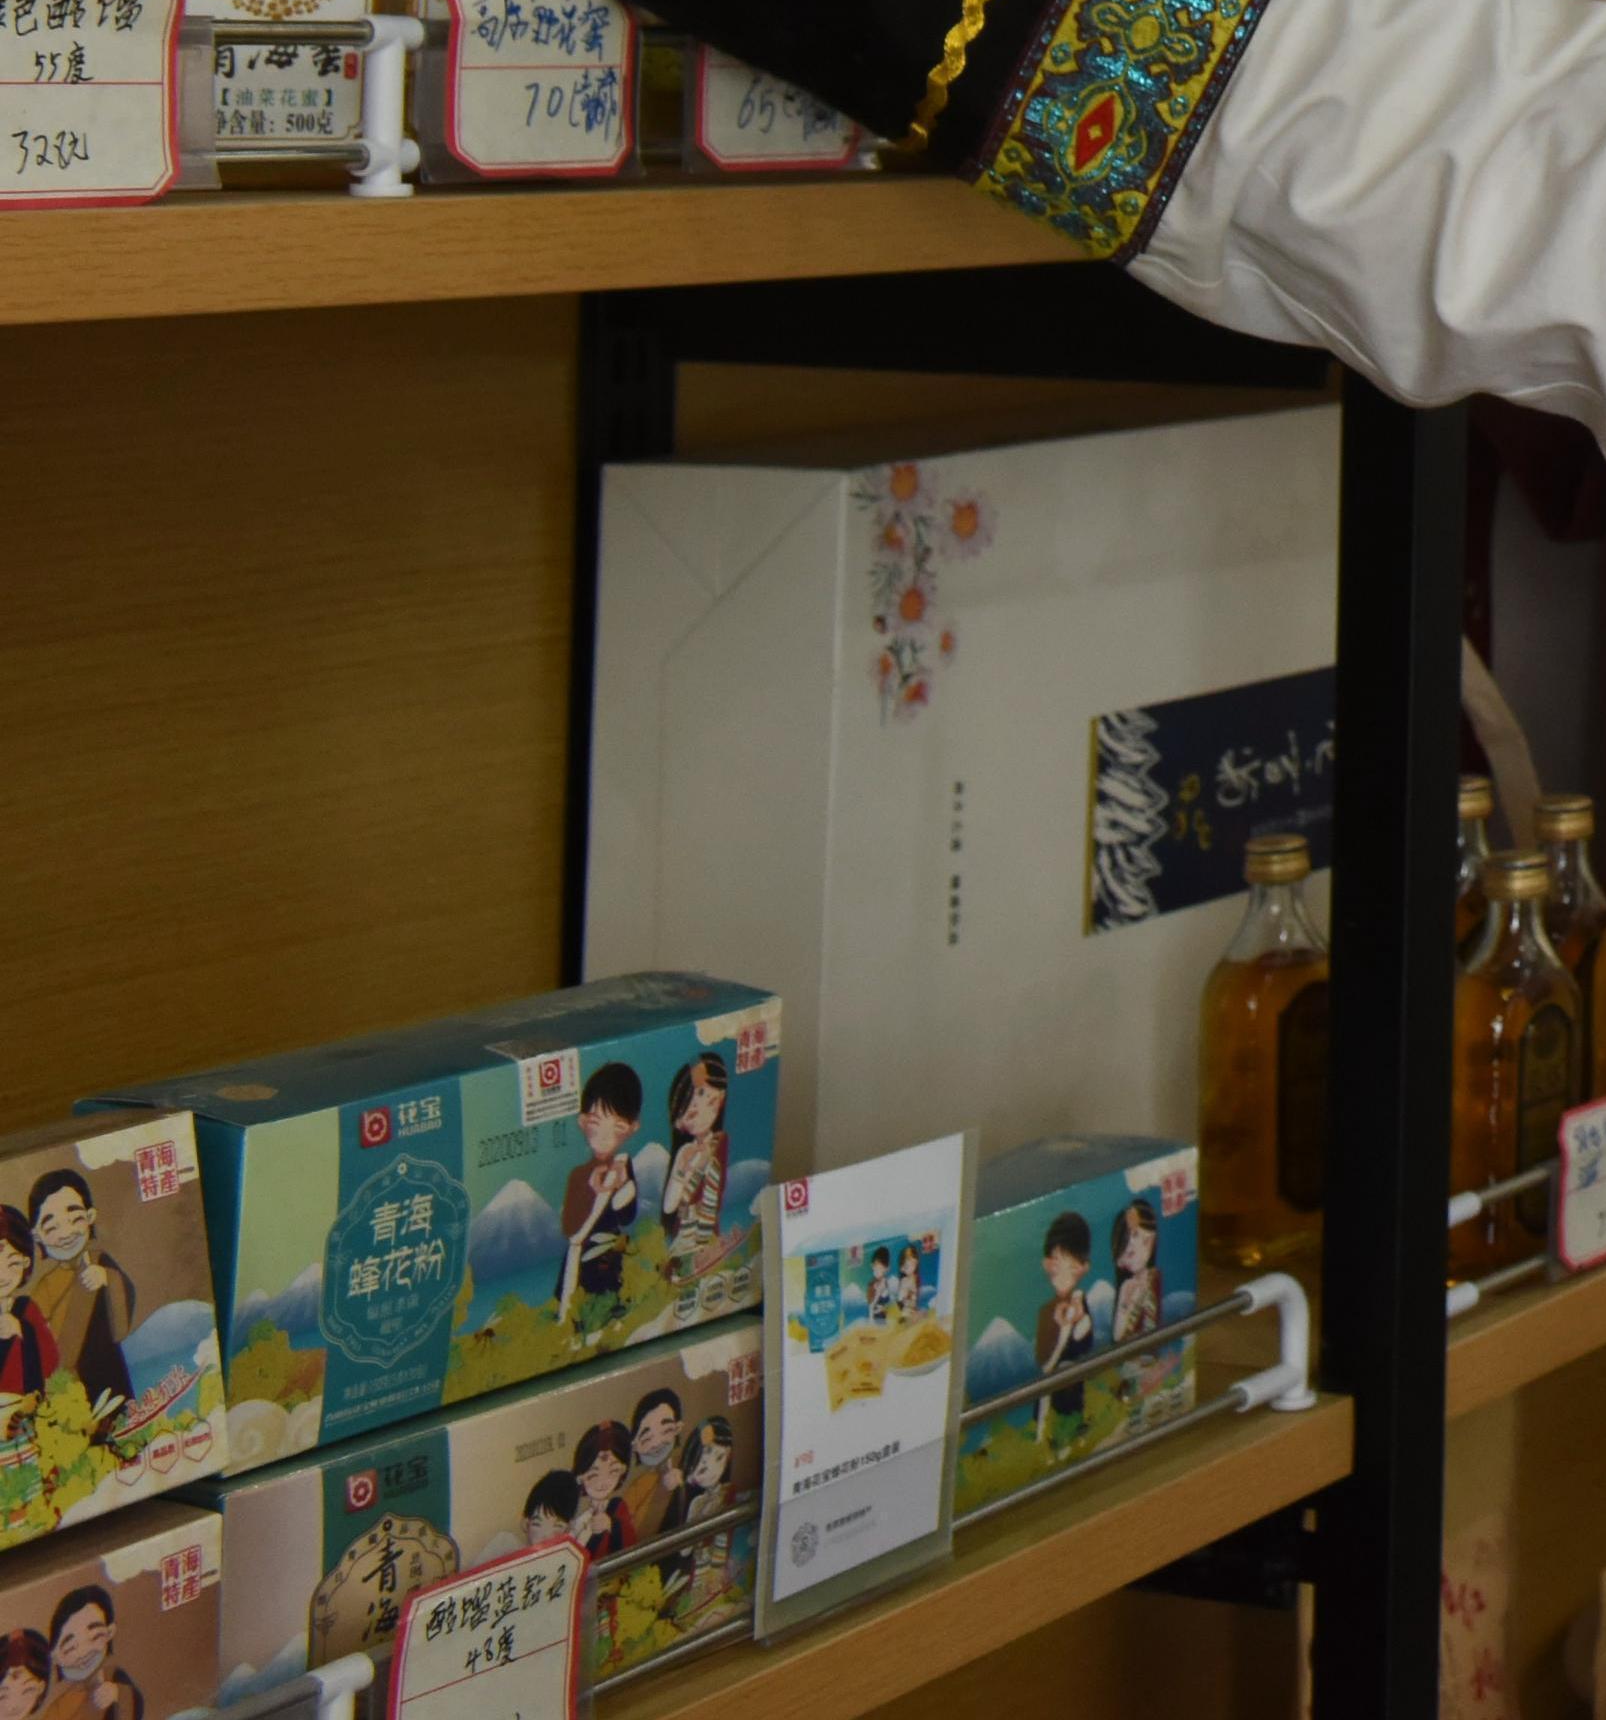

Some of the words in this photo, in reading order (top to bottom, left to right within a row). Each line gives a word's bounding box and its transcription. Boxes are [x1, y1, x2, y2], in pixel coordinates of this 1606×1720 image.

[34, 41, 95, 84] 55度
[369, 1192, 434, 1246] 青海
[346, 1237, 447, 1302] 蜂花粉
[464, 1625, 518, 1674] 48度
